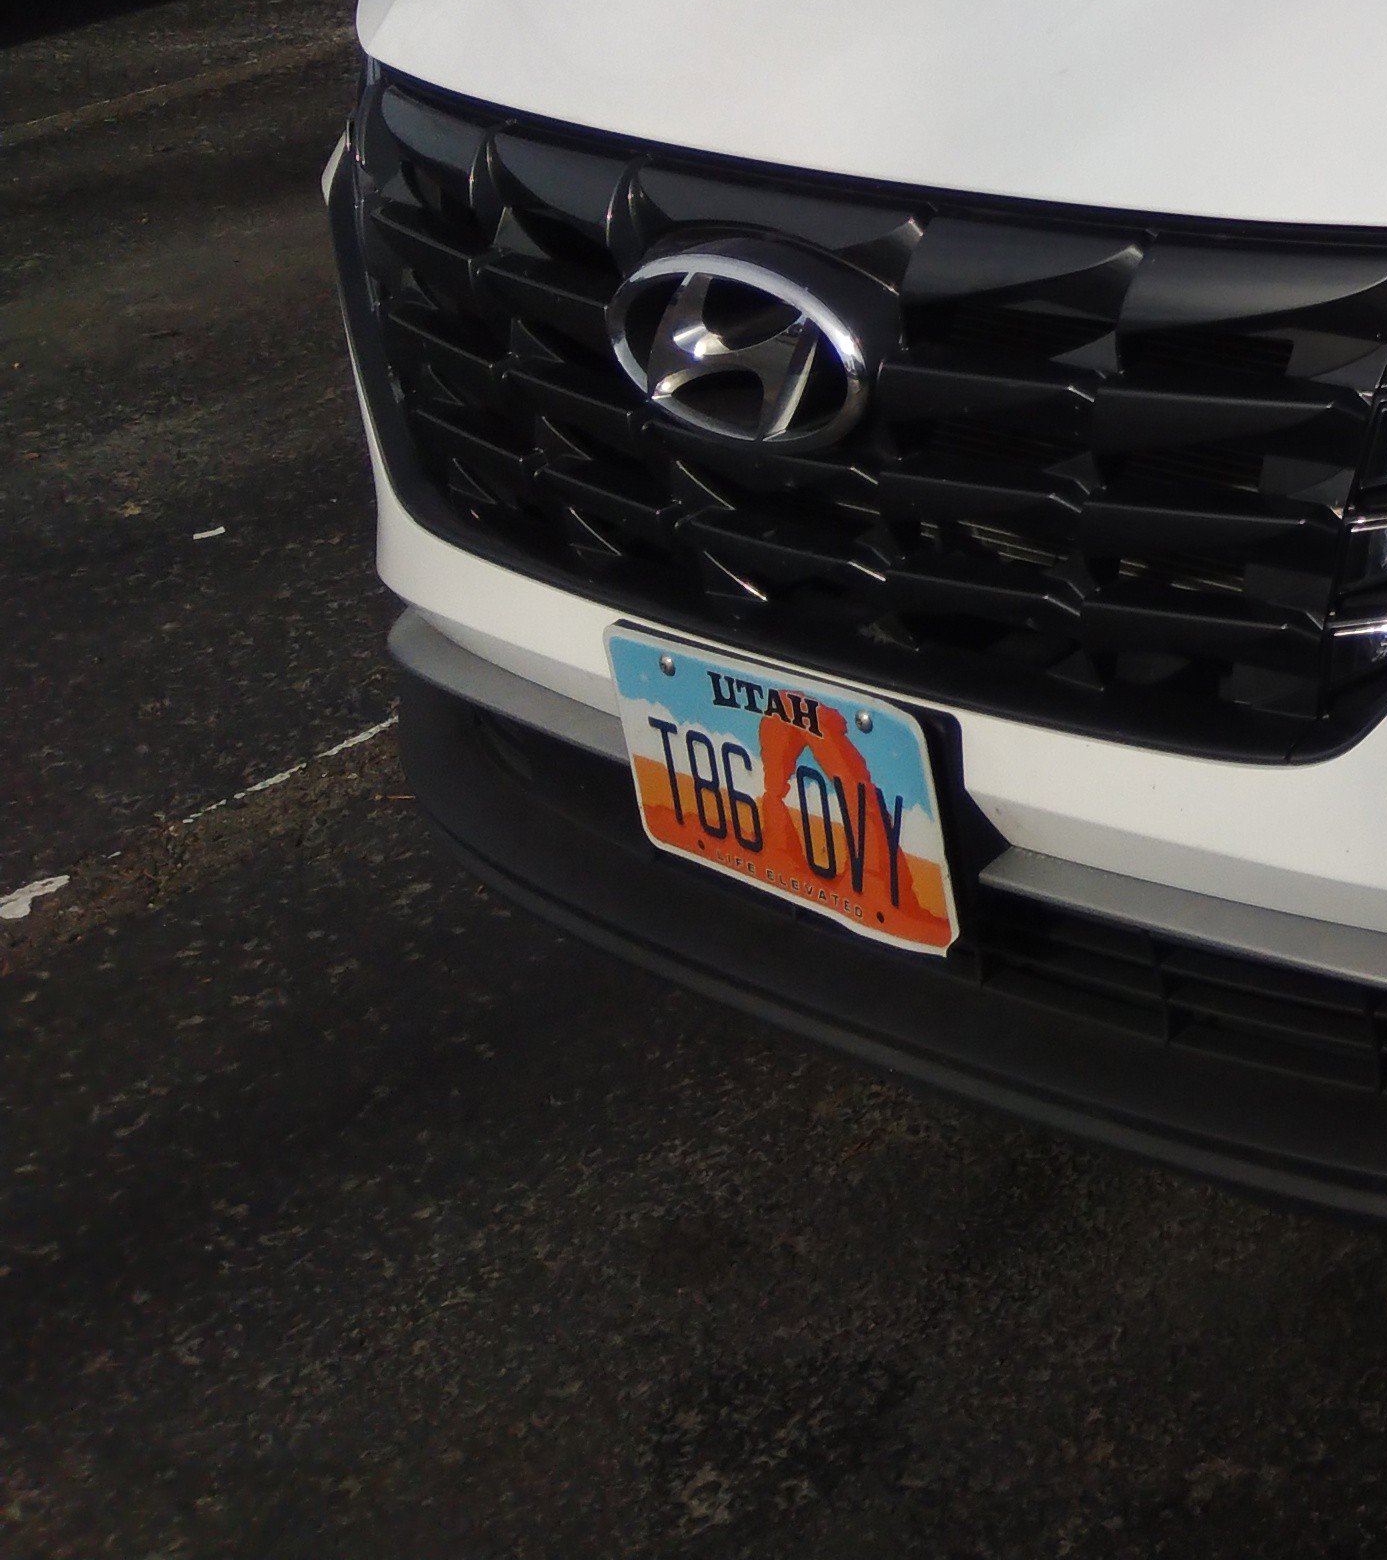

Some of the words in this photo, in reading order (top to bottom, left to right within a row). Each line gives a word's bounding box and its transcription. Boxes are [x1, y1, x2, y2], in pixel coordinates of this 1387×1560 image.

[707, 671, 823, 738] UTAH
[648, 716, 762, 853] T86
[716, 849, 756, 875] LIFE
[766, 868, 863, 921] ELEVATED
